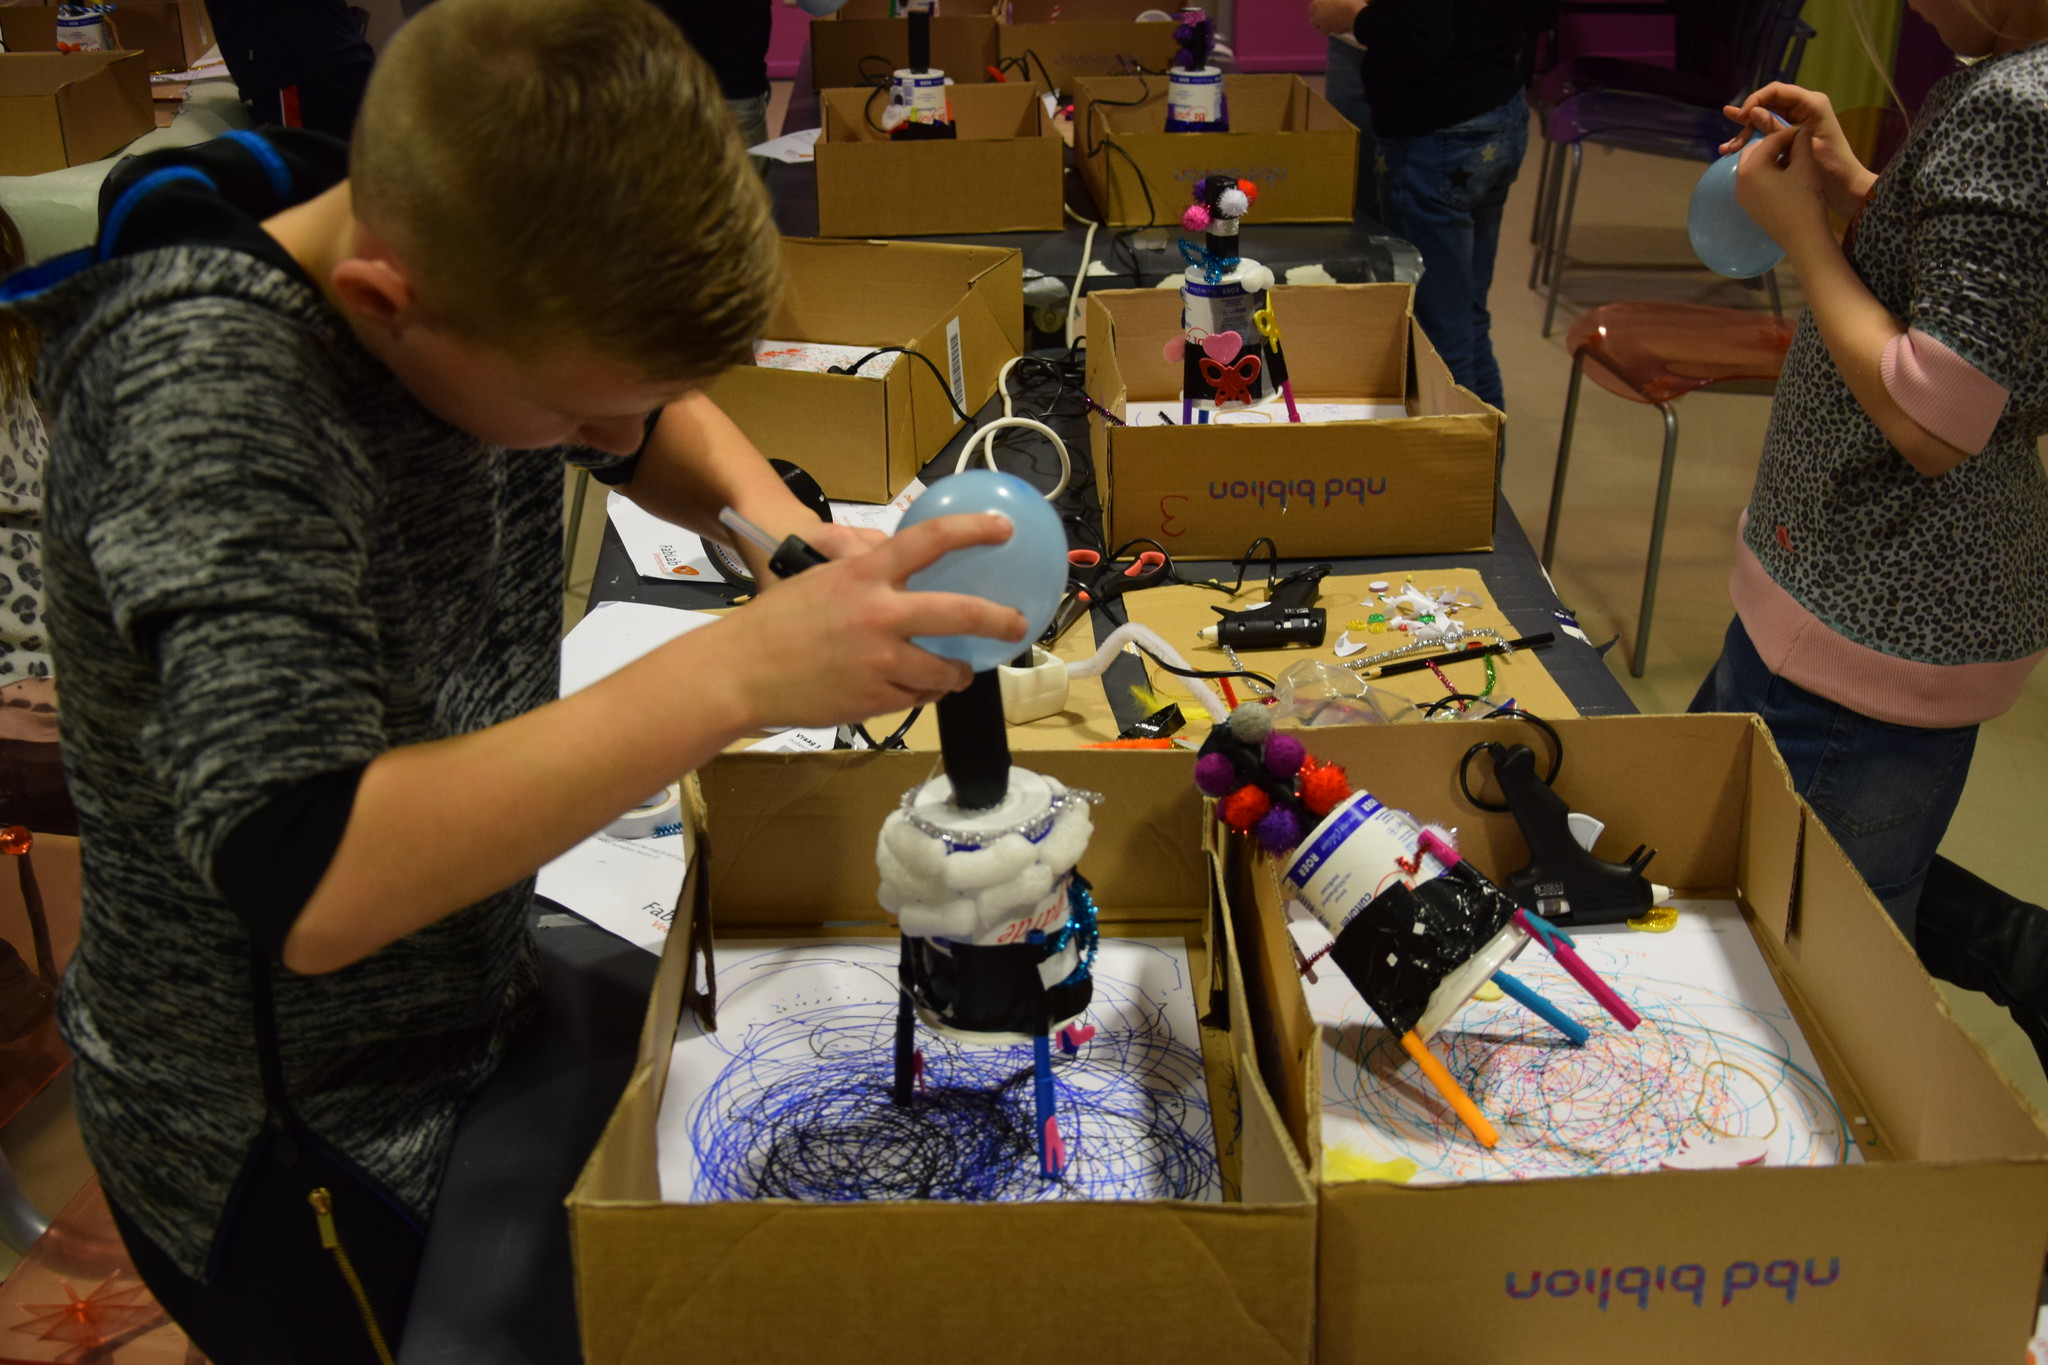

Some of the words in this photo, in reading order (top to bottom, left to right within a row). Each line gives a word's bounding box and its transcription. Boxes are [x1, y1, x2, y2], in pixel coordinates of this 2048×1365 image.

[1209, 479, 1316, 509] biblion
[1324, 477, 1387, 509] nbd
[659, 545, 682, 566] FabLab
[796, 733, 817, 747] Vraag
[1297, 852, 1320, 878] ROER
[1504, 1262, 1707, 1313] biblion
[1722, 1256, 1840, 1309] nbd
